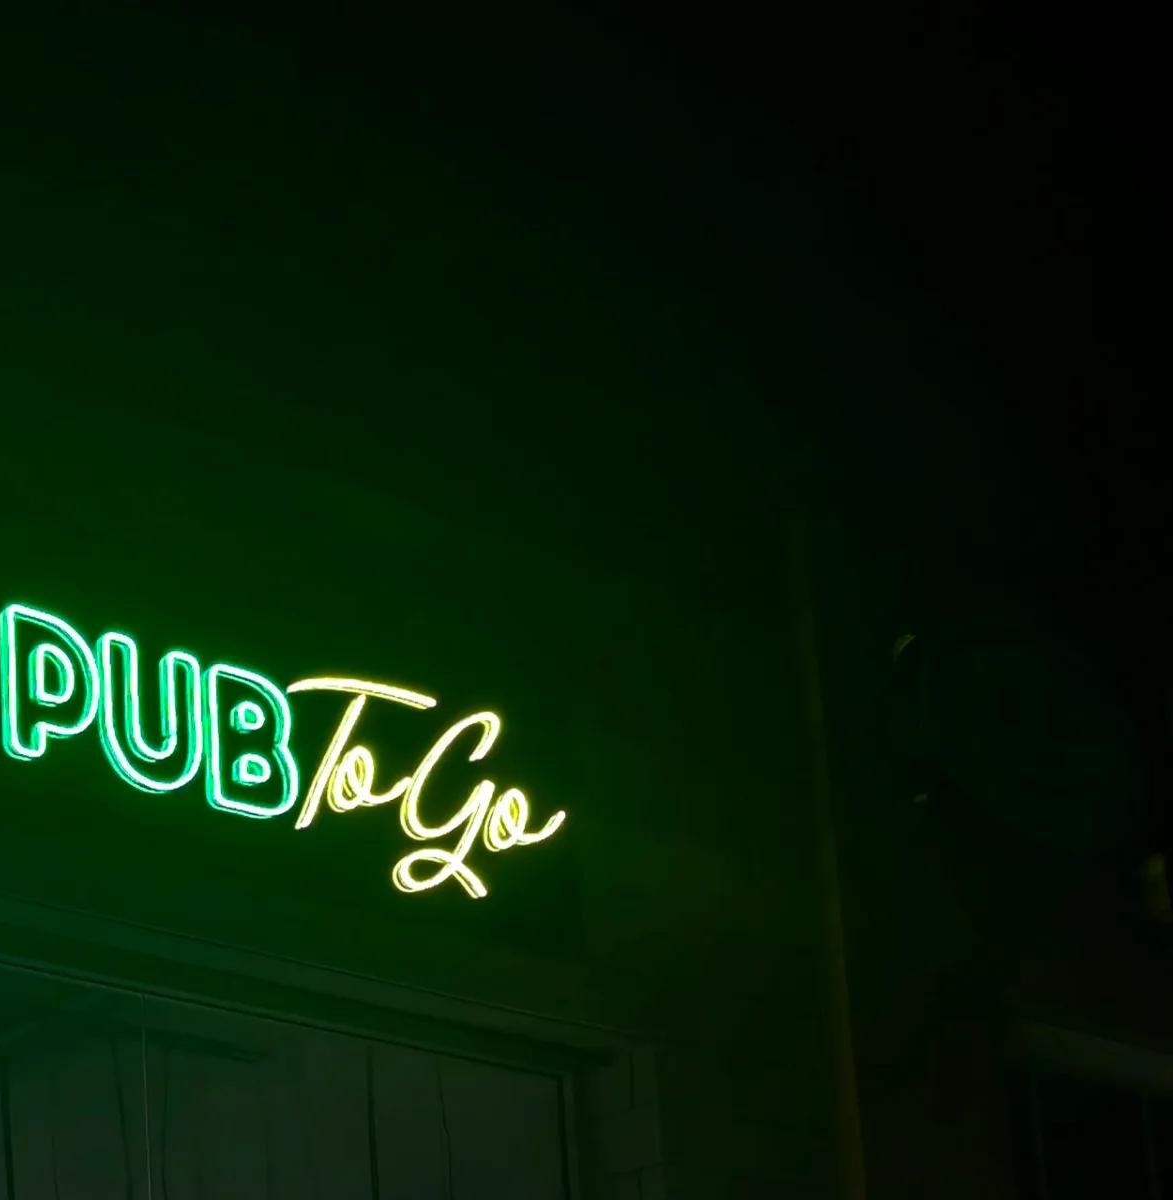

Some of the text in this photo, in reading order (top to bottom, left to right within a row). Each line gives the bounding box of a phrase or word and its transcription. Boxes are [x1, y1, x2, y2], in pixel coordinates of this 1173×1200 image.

[0, 603, 298, 818] PUB
[286, 676, 566, 899] To Go
